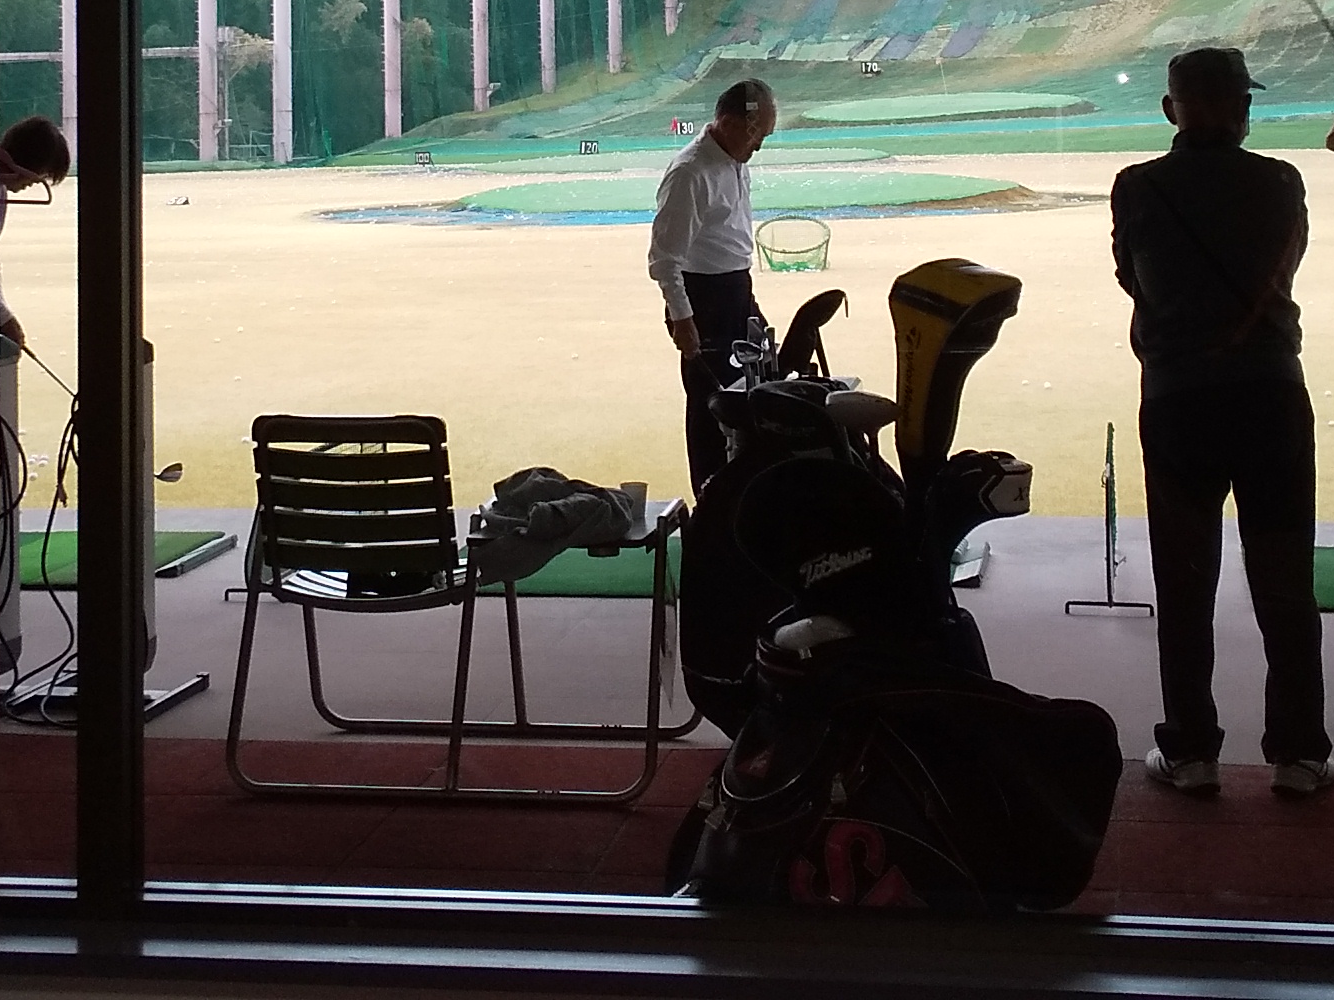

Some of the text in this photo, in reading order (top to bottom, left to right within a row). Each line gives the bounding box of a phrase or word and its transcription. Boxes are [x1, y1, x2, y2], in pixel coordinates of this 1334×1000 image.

[862, 62, 878, 73] 170
[677, 122, 694, 135] 130
[581, 141, 598, 154] 120
[415, 152, 430, 163] 100
